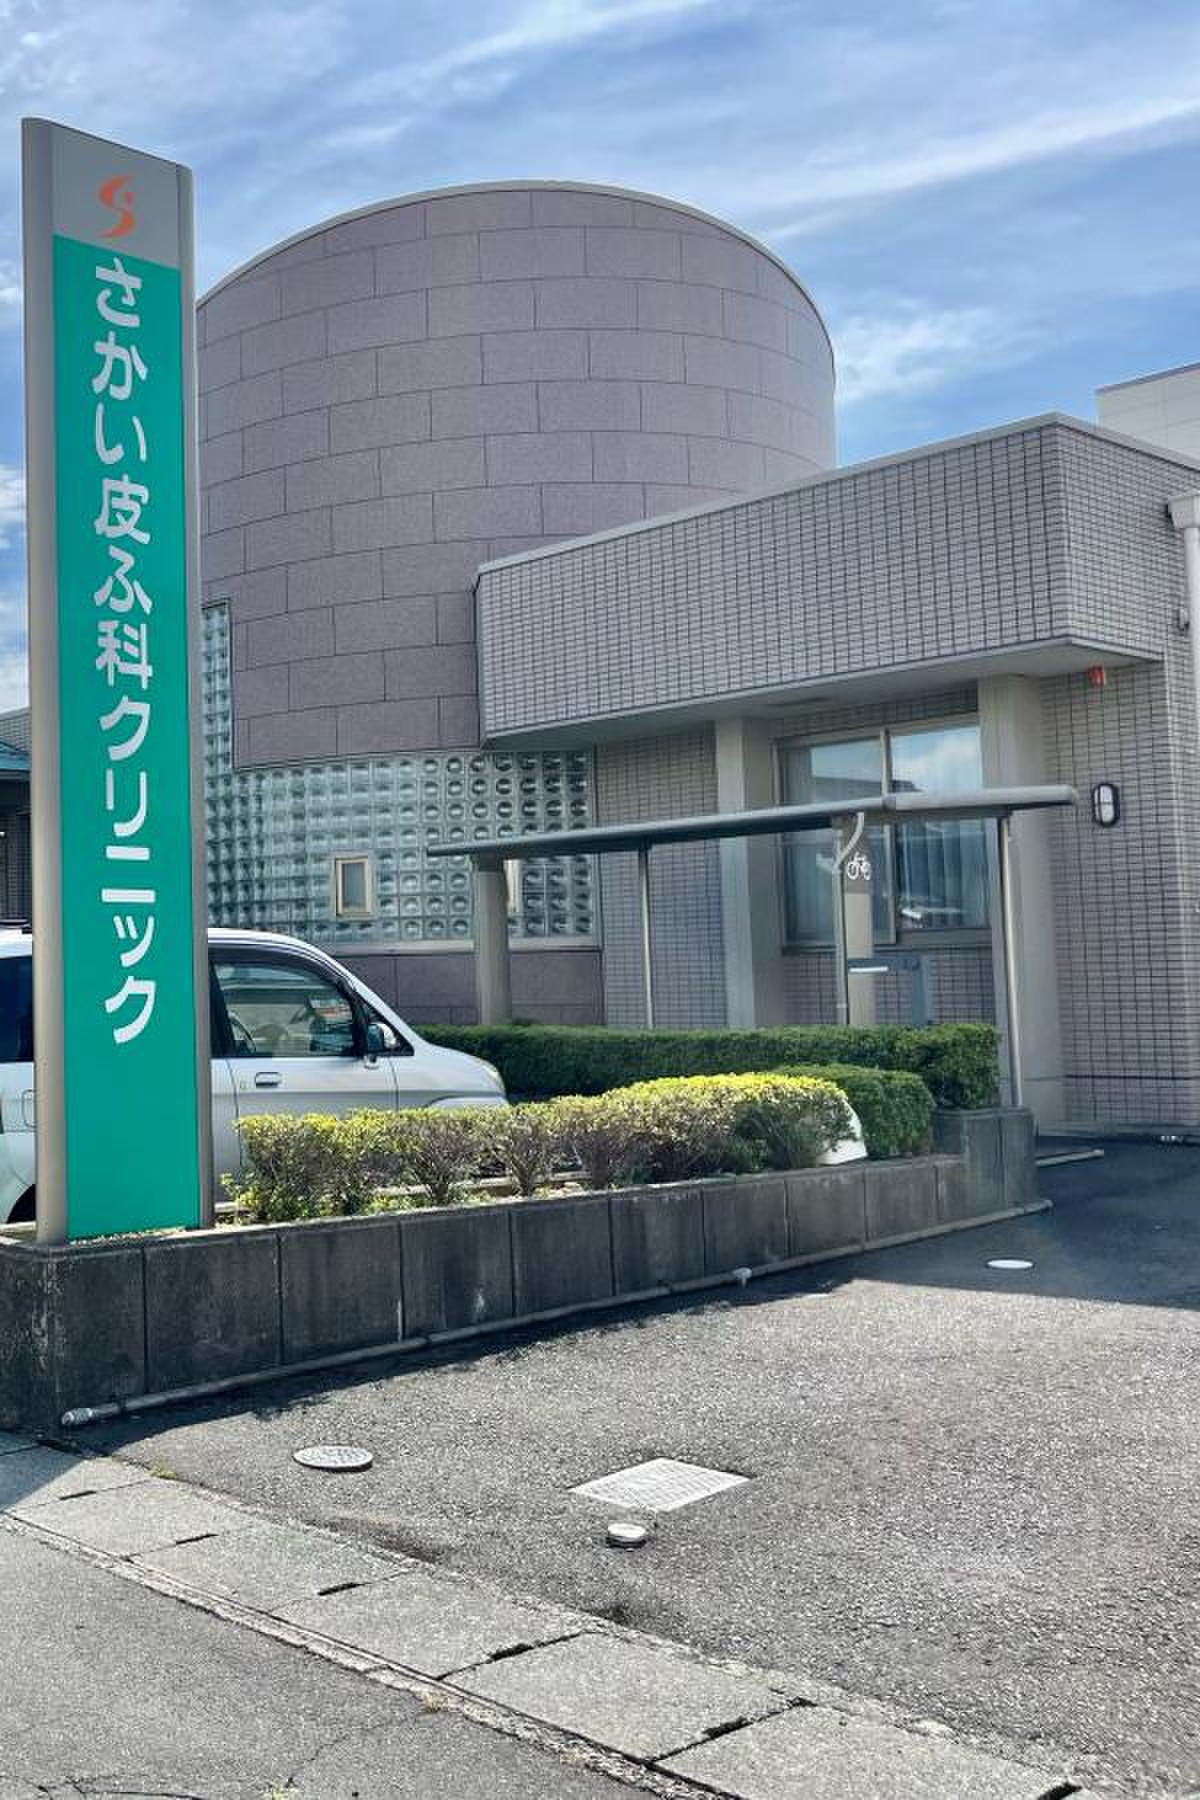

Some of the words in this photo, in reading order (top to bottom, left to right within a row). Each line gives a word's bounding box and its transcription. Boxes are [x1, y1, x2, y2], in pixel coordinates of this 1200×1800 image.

[92, 257, 156, 1044] さかい皮ふ科クリニック
